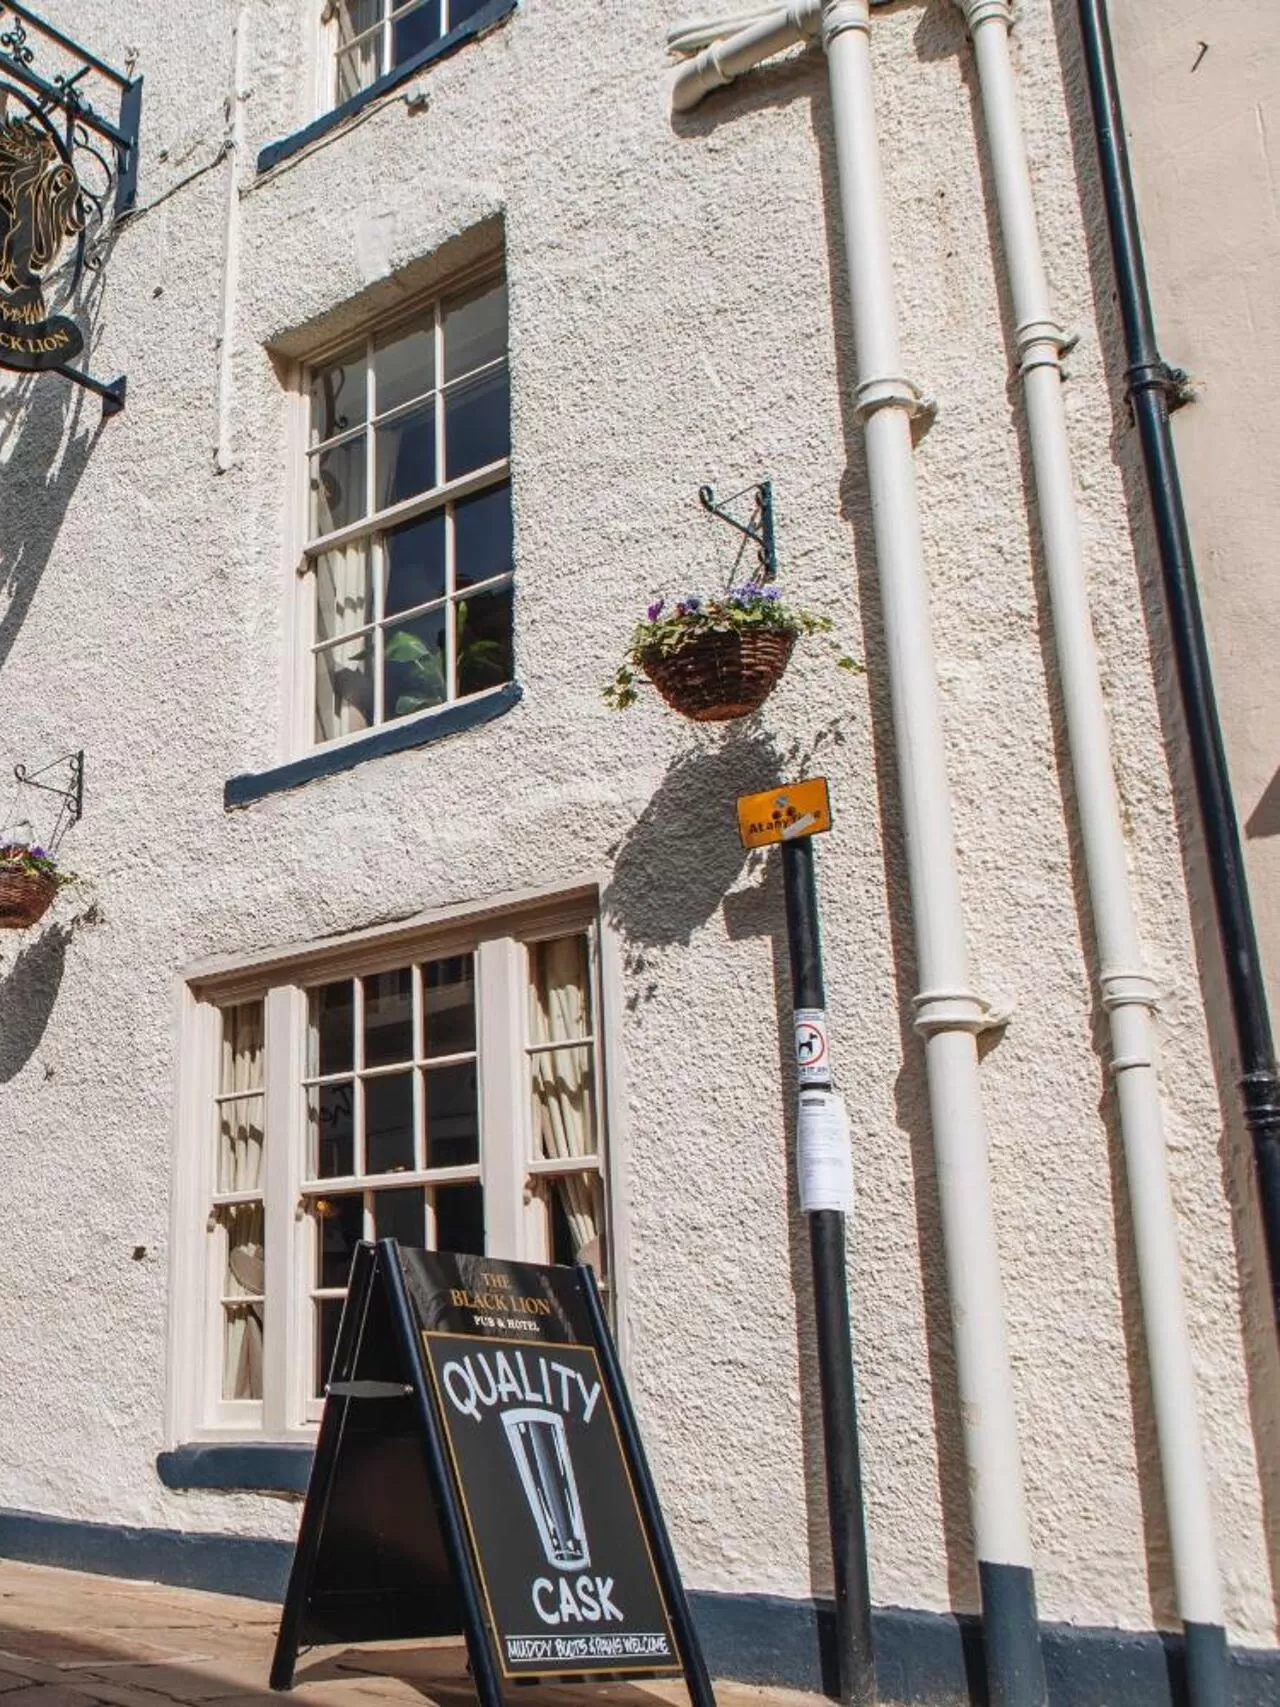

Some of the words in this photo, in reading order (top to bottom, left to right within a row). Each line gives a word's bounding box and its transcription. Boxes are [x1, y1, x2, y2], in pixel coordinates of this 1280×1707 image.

[28, 328, 69, 353] LION
[480, 1272, 512, 1289] THE
[450, 1288, 508, 1312] BLACK
[510, 1295, 551, 1315] LION
[473, 1315, 495, 1327] PUB
[497, 1317, 505, 1328] &
[506, 1319, 540, 1332] HOTEL
[443, 1350, 601, 1424] QUALITY
[532, 1575, 624, 1625] CASK
[507, 1639, 552, 1658] MUDDY
[555, 1638, 588, 1657] BOOTS
[622, 1636, 669, 1655] WELCOME
